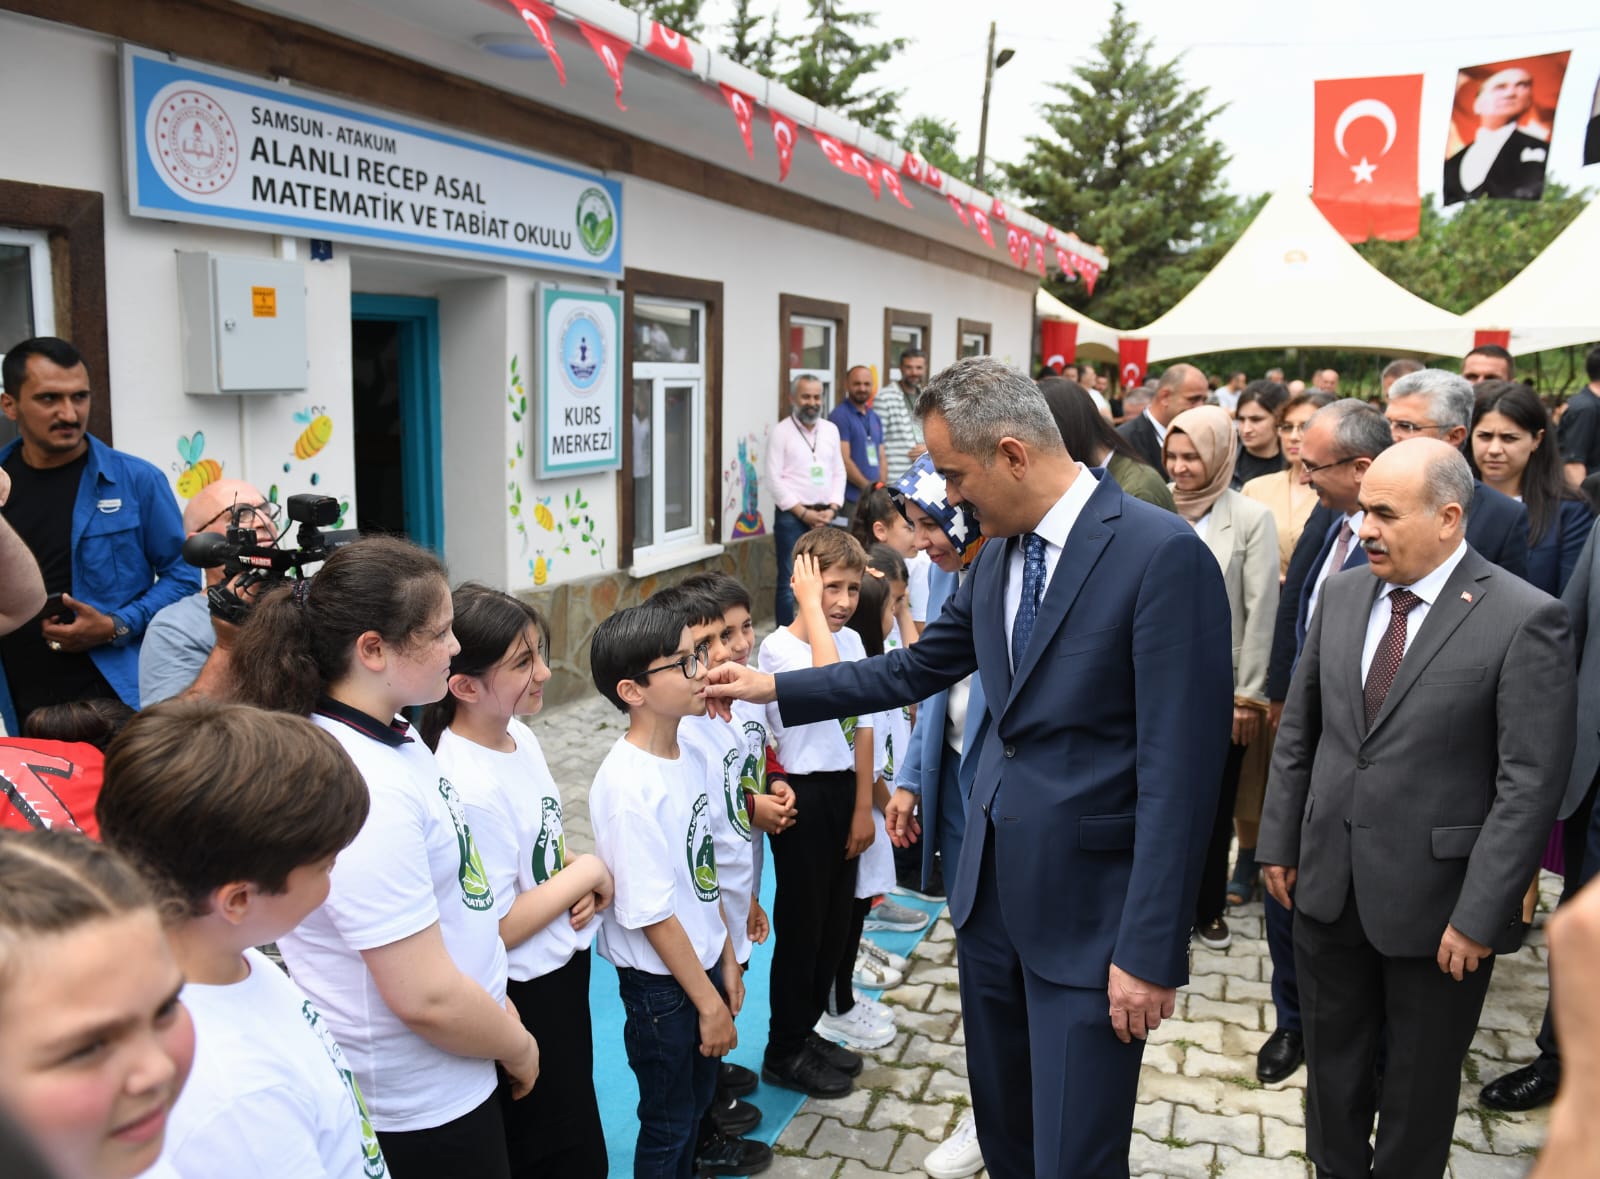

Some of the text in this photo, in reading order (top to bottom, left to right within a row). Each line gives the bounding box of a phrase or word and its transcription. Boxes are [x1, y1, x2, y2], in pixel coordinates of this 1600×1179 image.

[252, 106, 323, 138] SAMSUN
[336, 126, 397, 154] ATAKUM
[251, 136, 349, 178] ALANLI
[357, 157, 428, 192] RECEP
[434, 175, 486, 205] ASAL
[252, 175, 571, 250] MATEMATİK VE TABİAT OKULU
[565, 406, 601, 427] KURS
[552, 427, 612, 455] MERKEZİ
